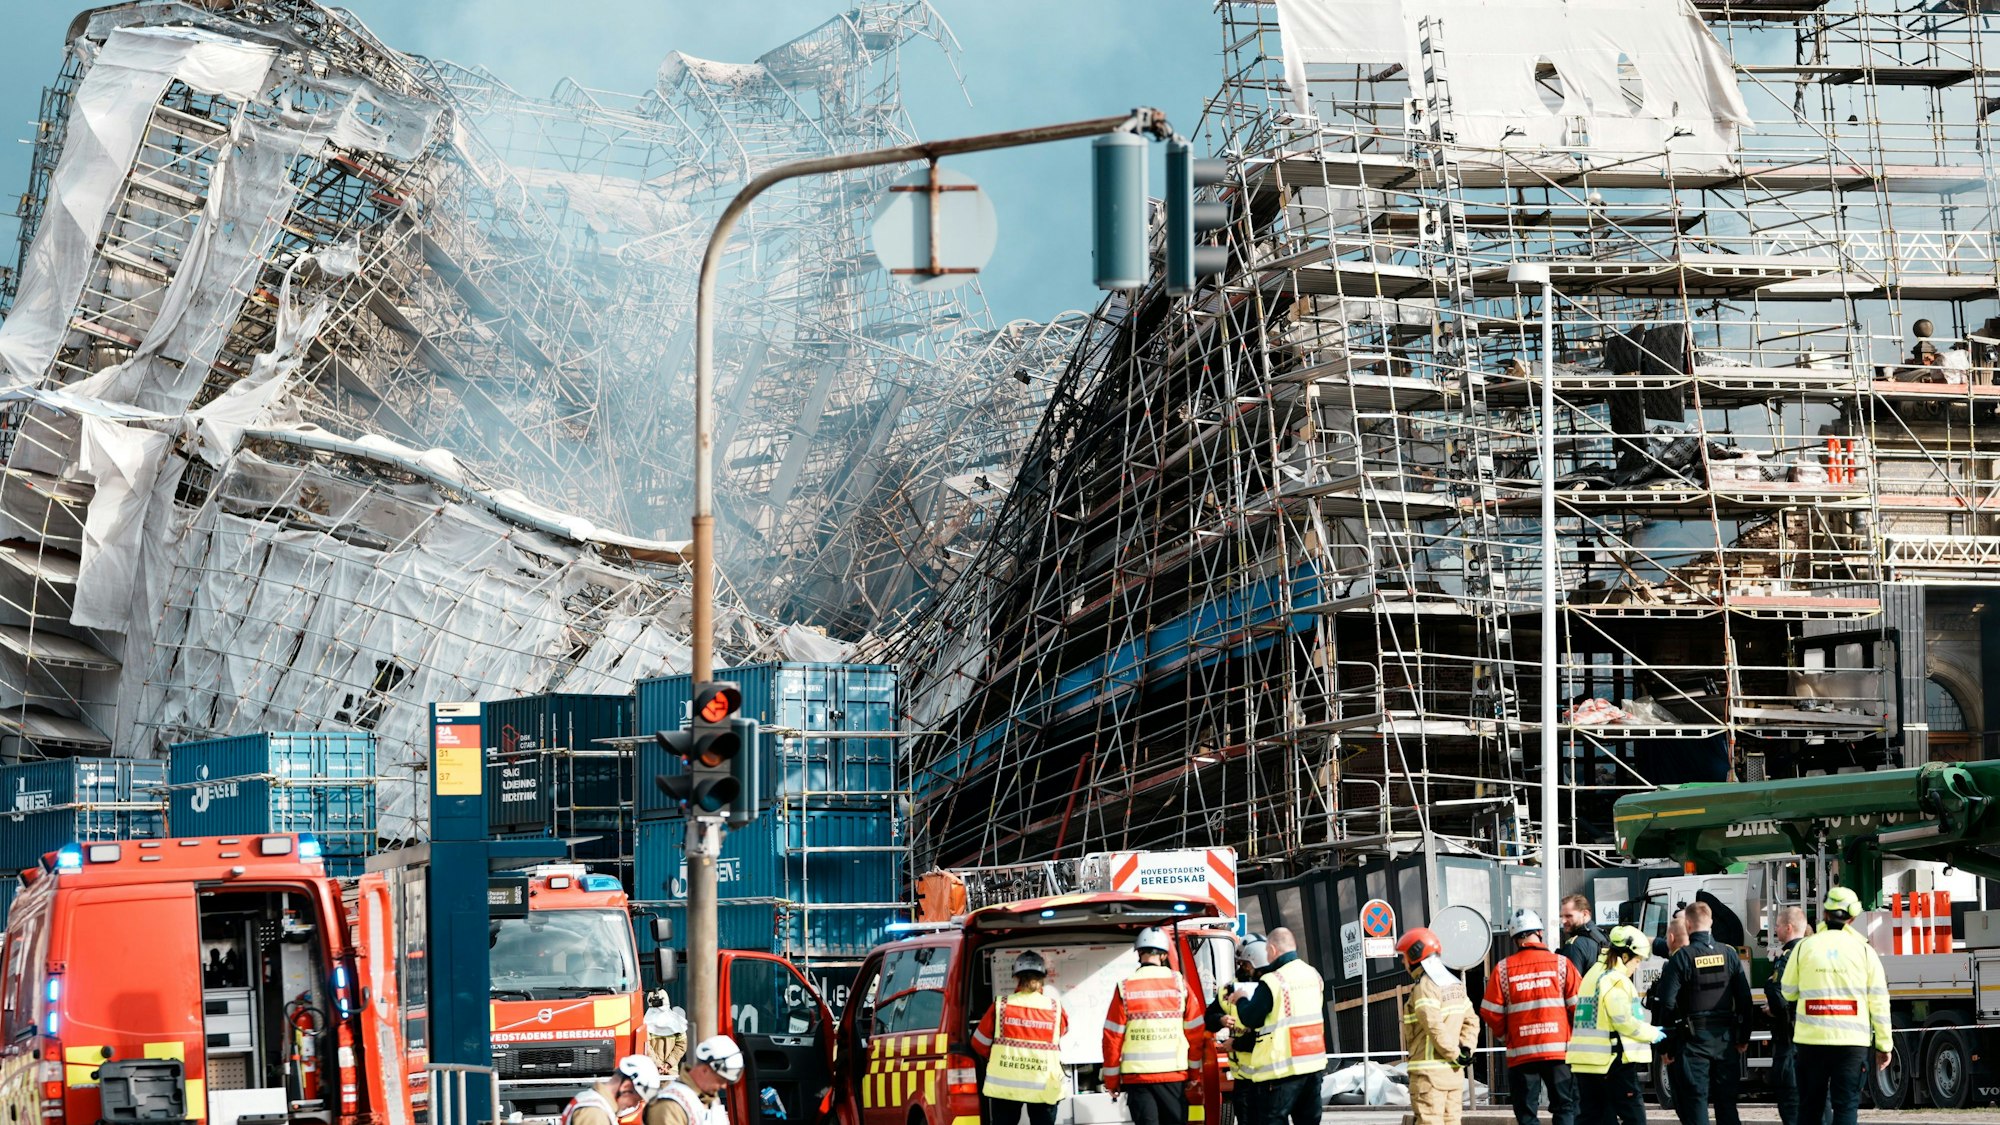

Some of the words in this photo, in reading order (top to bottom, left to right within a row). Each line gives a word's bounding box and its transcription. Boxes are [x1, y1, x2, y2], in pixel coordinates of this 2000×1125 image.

[438, 750, 448, 758] 31
[439, 773, 450, 781] 37
[1140, 866, 1205, 876] HOVEDSTADENS
[1141, 874, 1206, 886] BEREDSKAB
[1696, 956, 1724, 967] POLITI
[1516, 978, 1552, 991] BRAND
[556, 1029, 615, 1039] BEREDSKAB
[1000, 1061, 1048, 1072] BEREDSKAB
